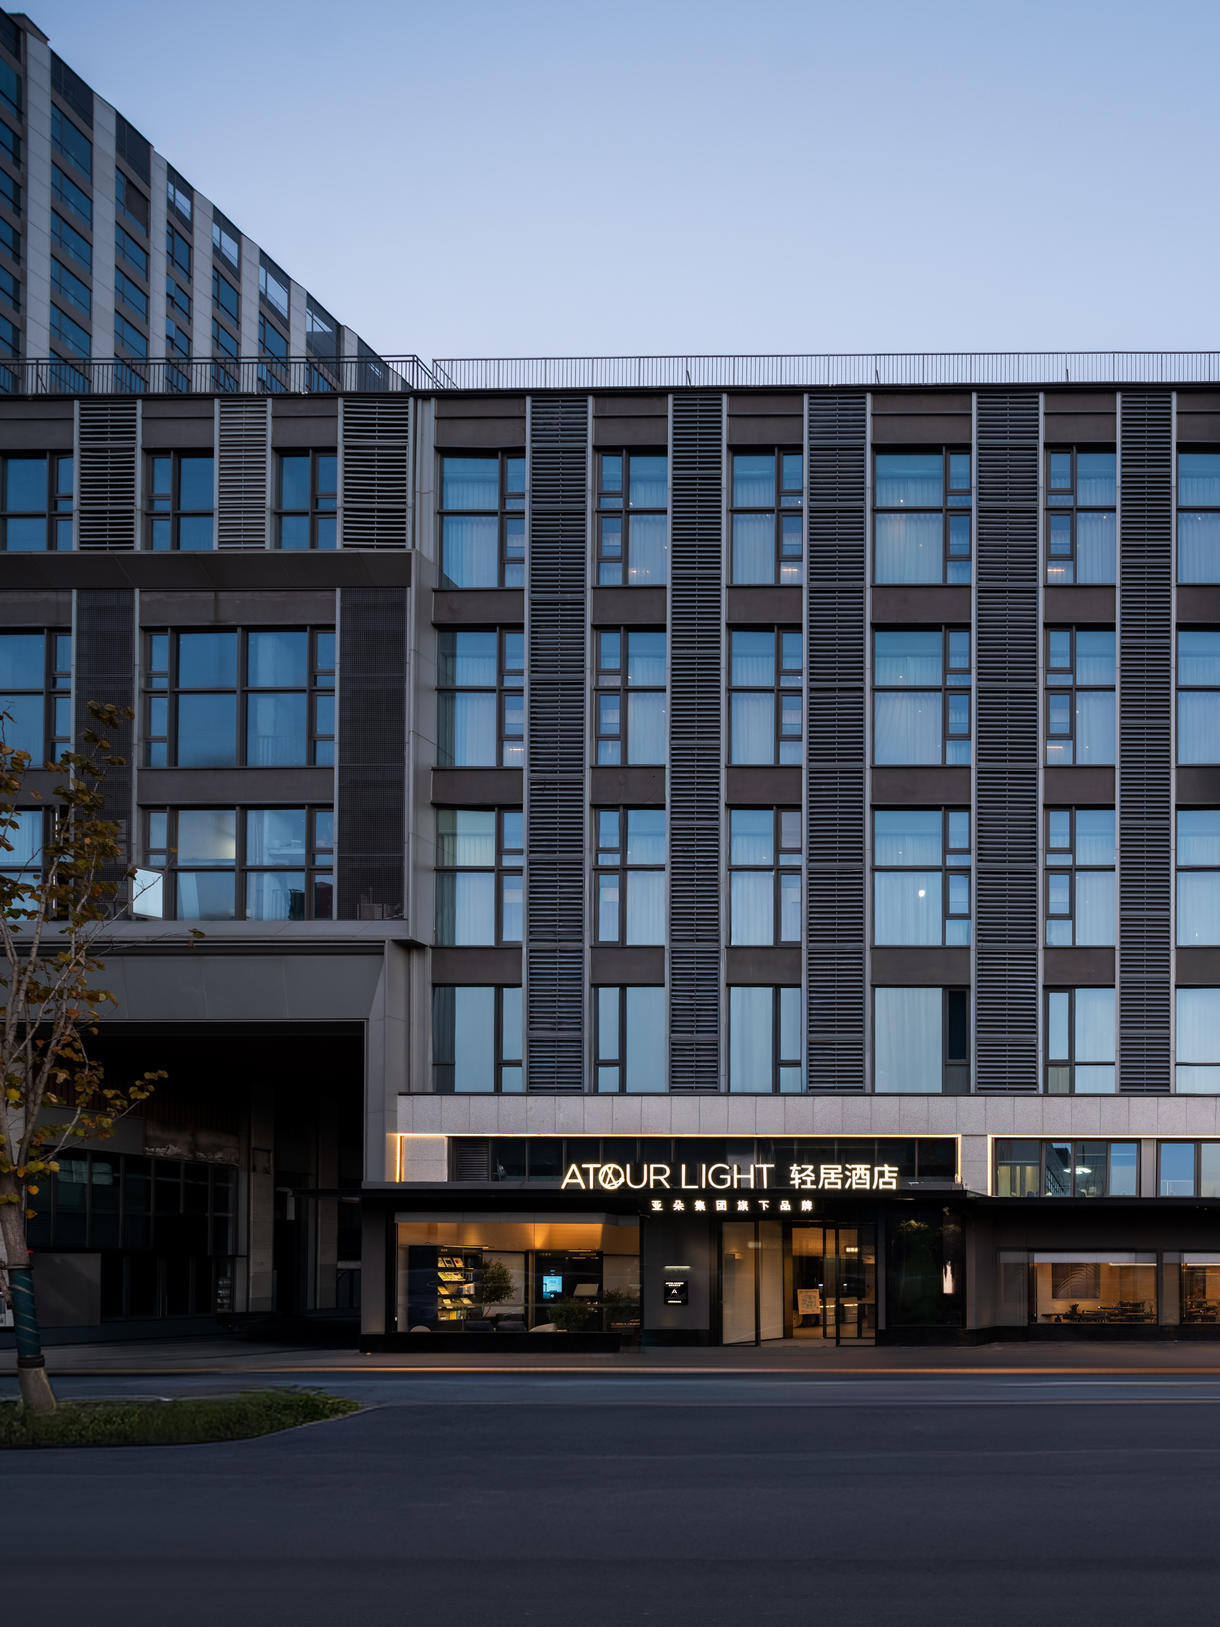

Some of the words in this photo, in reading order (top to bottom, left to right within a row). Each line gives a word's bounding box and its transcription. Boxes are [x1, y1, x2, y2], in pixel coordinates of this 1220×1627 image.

[560, 1163, 671, 1190] ATOUR
[681, 1163, 775, 1189] LIGHT
[789, 1163, 899, 1190] 轻居酒店
[651, 1199, 813, 1212] 亚朵集团旗下品牌
